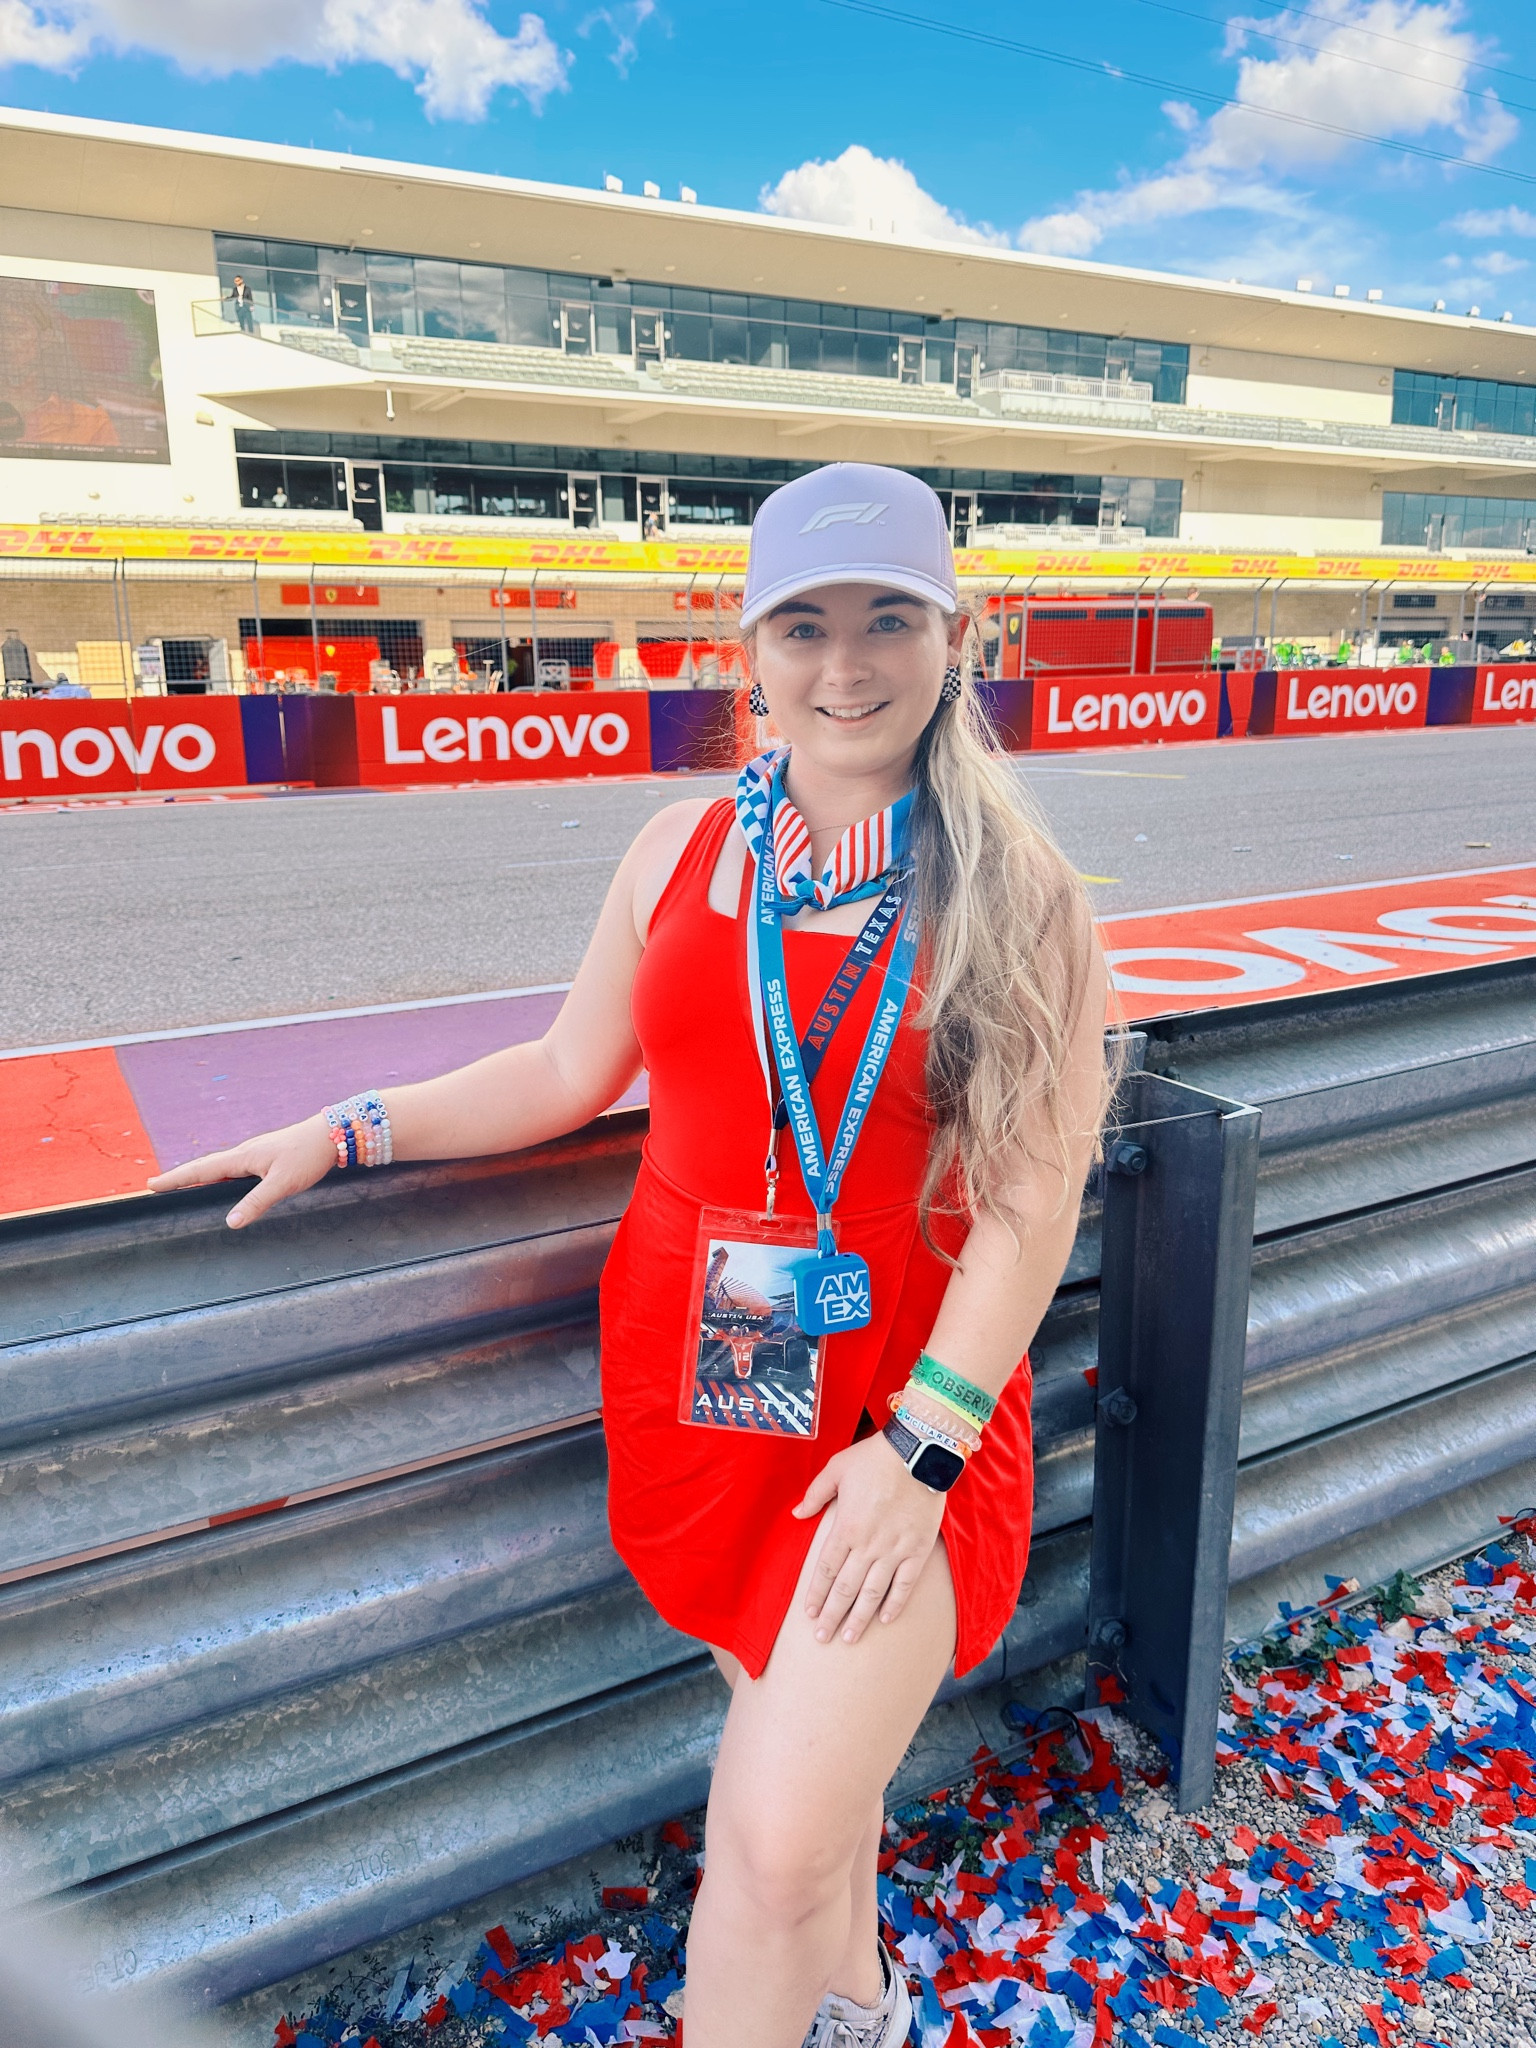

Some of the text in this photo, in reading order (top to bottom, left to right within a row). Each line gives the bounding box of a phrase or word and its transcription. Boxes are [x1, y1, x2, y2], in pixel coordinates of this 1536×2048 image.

[0, 530, 102, 553] DHL
[188, 535, 291, 557] DHL
[366, 540, 459, 561] DHL
[529, 544, 611, 565] DHL
[675, 548, 748, 568] DHL
[953, 554, 987, 571] HL
[1035, 555, 1092, 572] DHL
[1138, 557, 1190, 573] DHL
[1231, 559, 1279, 574] DHL
[1317, 561, 1363, 576] DHL
[1397, 563, 1440, 577] DHL
[1472, 565, 1512, 578] DHL
[1286, 677, 1418, 720] Lenovo
[1483, 671, 1536, 710] Len
[1047, 686, 1207, 733] Lenovo
[381, 706, 630, 764] Lenovo
[807, 894, 902, 1051] AUSTIN TEXAS
[767, 978, 821, 1178] AMERICAN EXPRESS
[825, 997, 899, 1194] AMERICAN EXPRESS
[814, 1269, 867, 1304] AM
[823, 1292, 870, 1325] EX
[738, 1351, 751, 1361] 12
[696, 1393, 810, 1419] AUSTIN
[758, 1416, 810, 1427] STATS
[904, 1414, 958, 1448] MCLAREN
